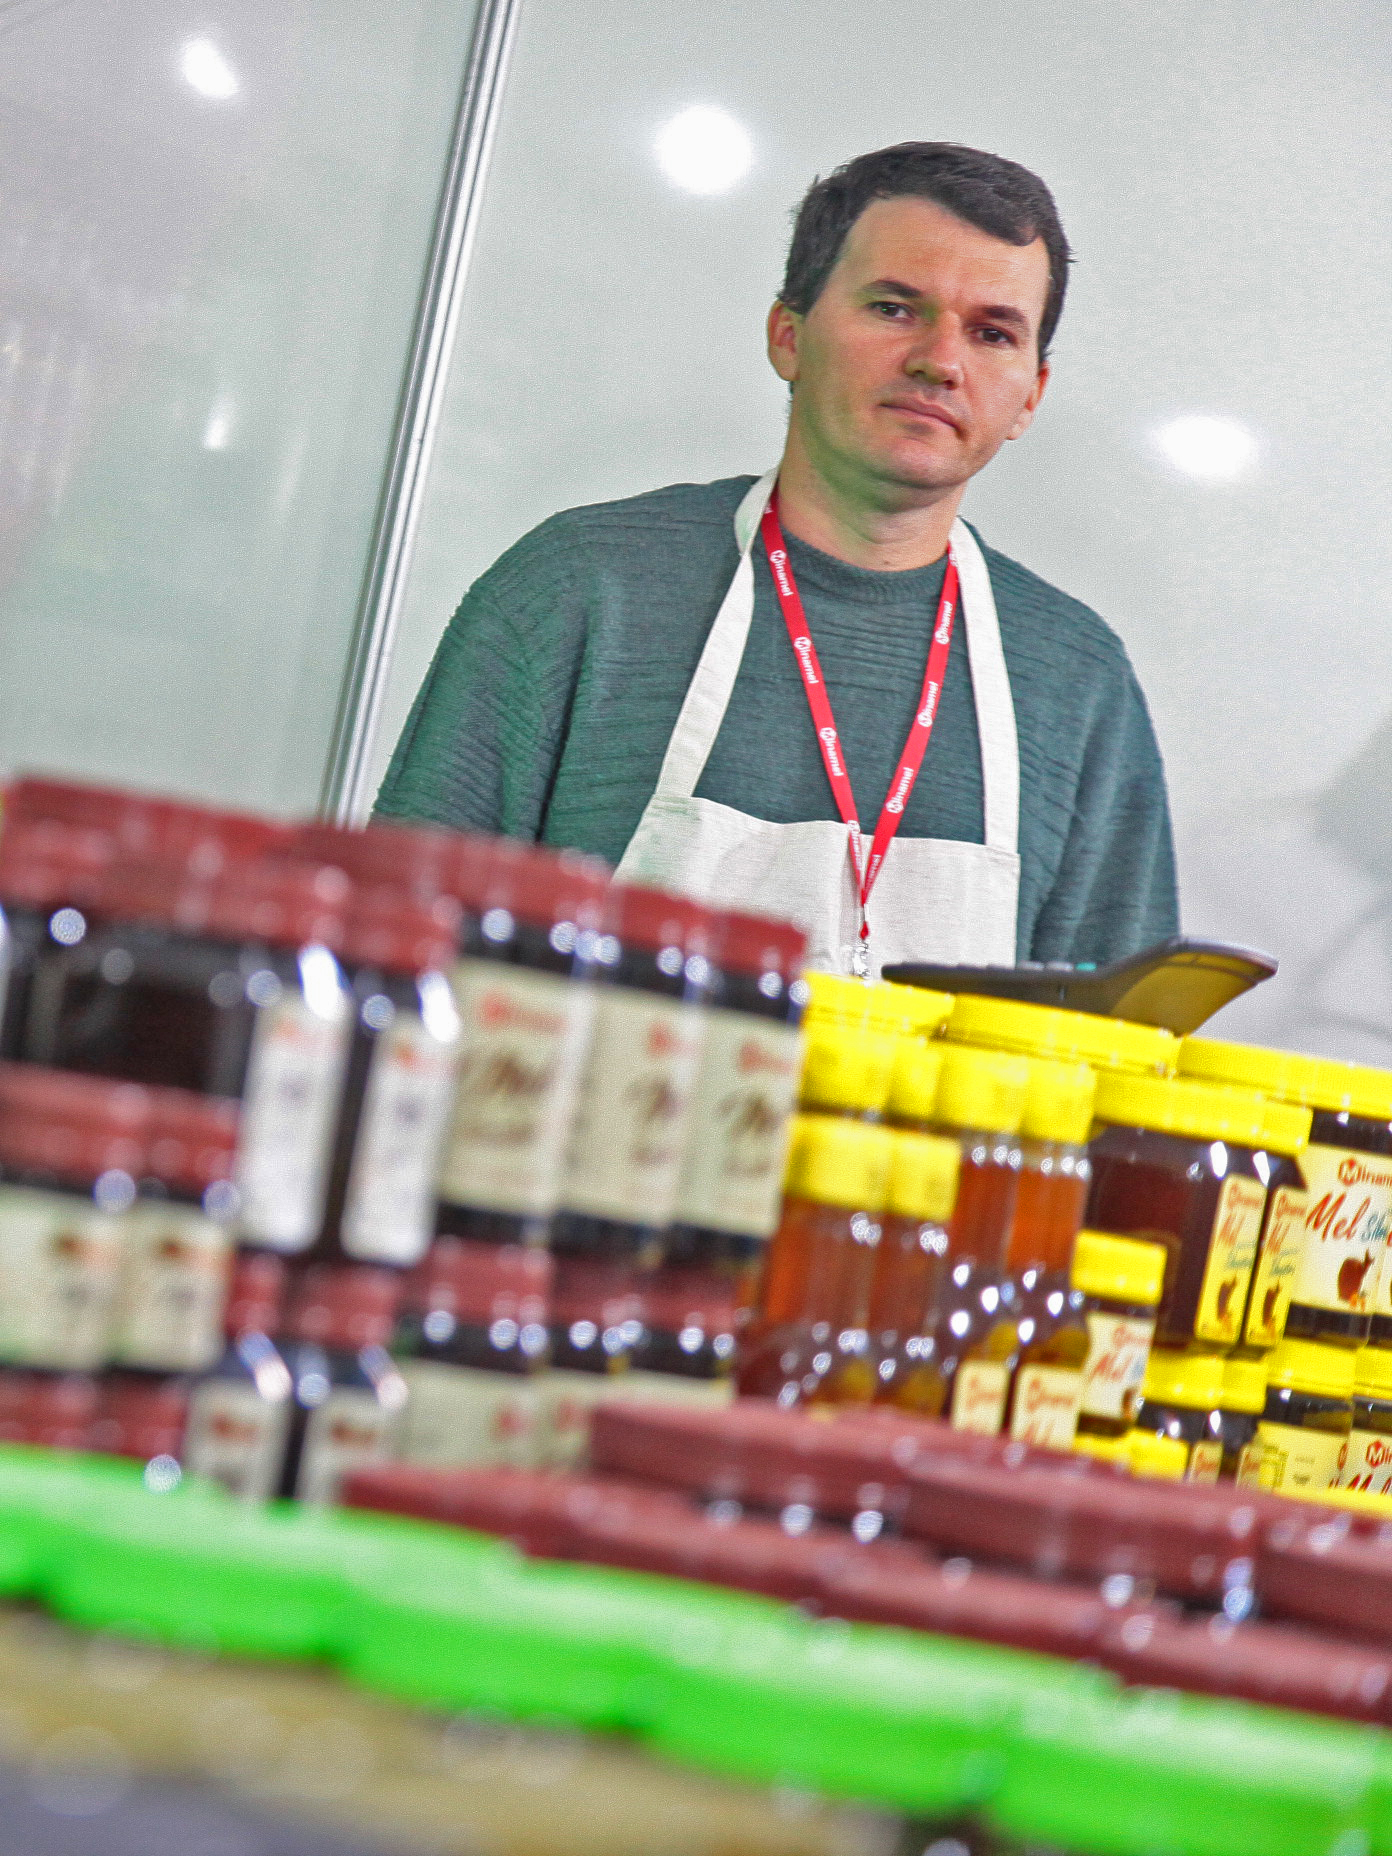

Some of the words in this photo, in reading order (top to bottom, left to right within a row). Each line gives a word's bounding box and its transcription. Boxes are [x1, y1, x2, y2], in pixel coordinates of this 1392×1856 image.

[769, 549, 794, 596] Minamel
[935, 600, 953, 645] Minamel
[793, 636, 819, 684] Minamel
[917, 681, 939, 728] Minamel
[819, 727, 845, 777] Minamel
[885, 766, 914, 814] Minamel
[1305, 1191, 1370, 1242] Mel
